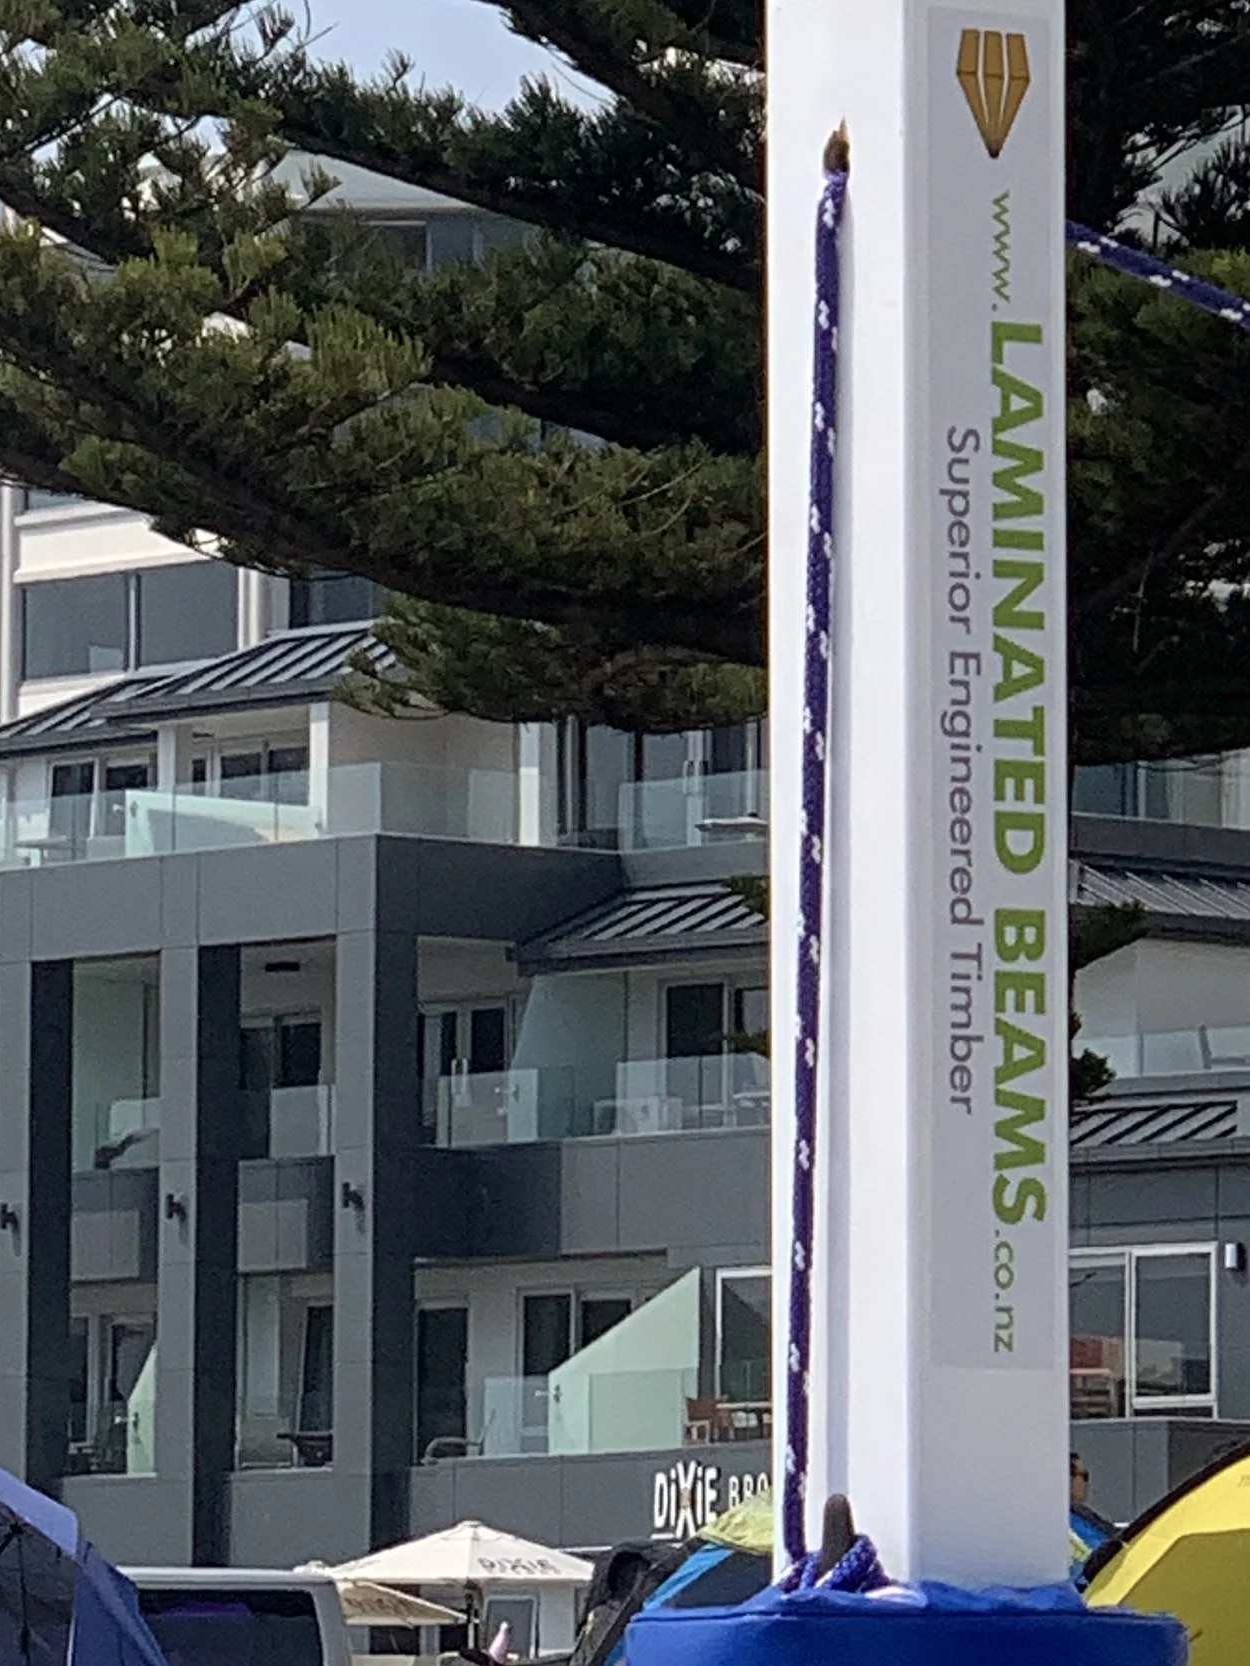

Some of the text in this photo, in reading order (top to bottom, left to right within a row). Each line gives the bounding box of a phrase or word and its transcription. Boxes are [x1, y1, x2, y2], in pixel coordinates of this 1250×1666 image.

[939, 425, 985, 1116] Superior Engineered Timber
